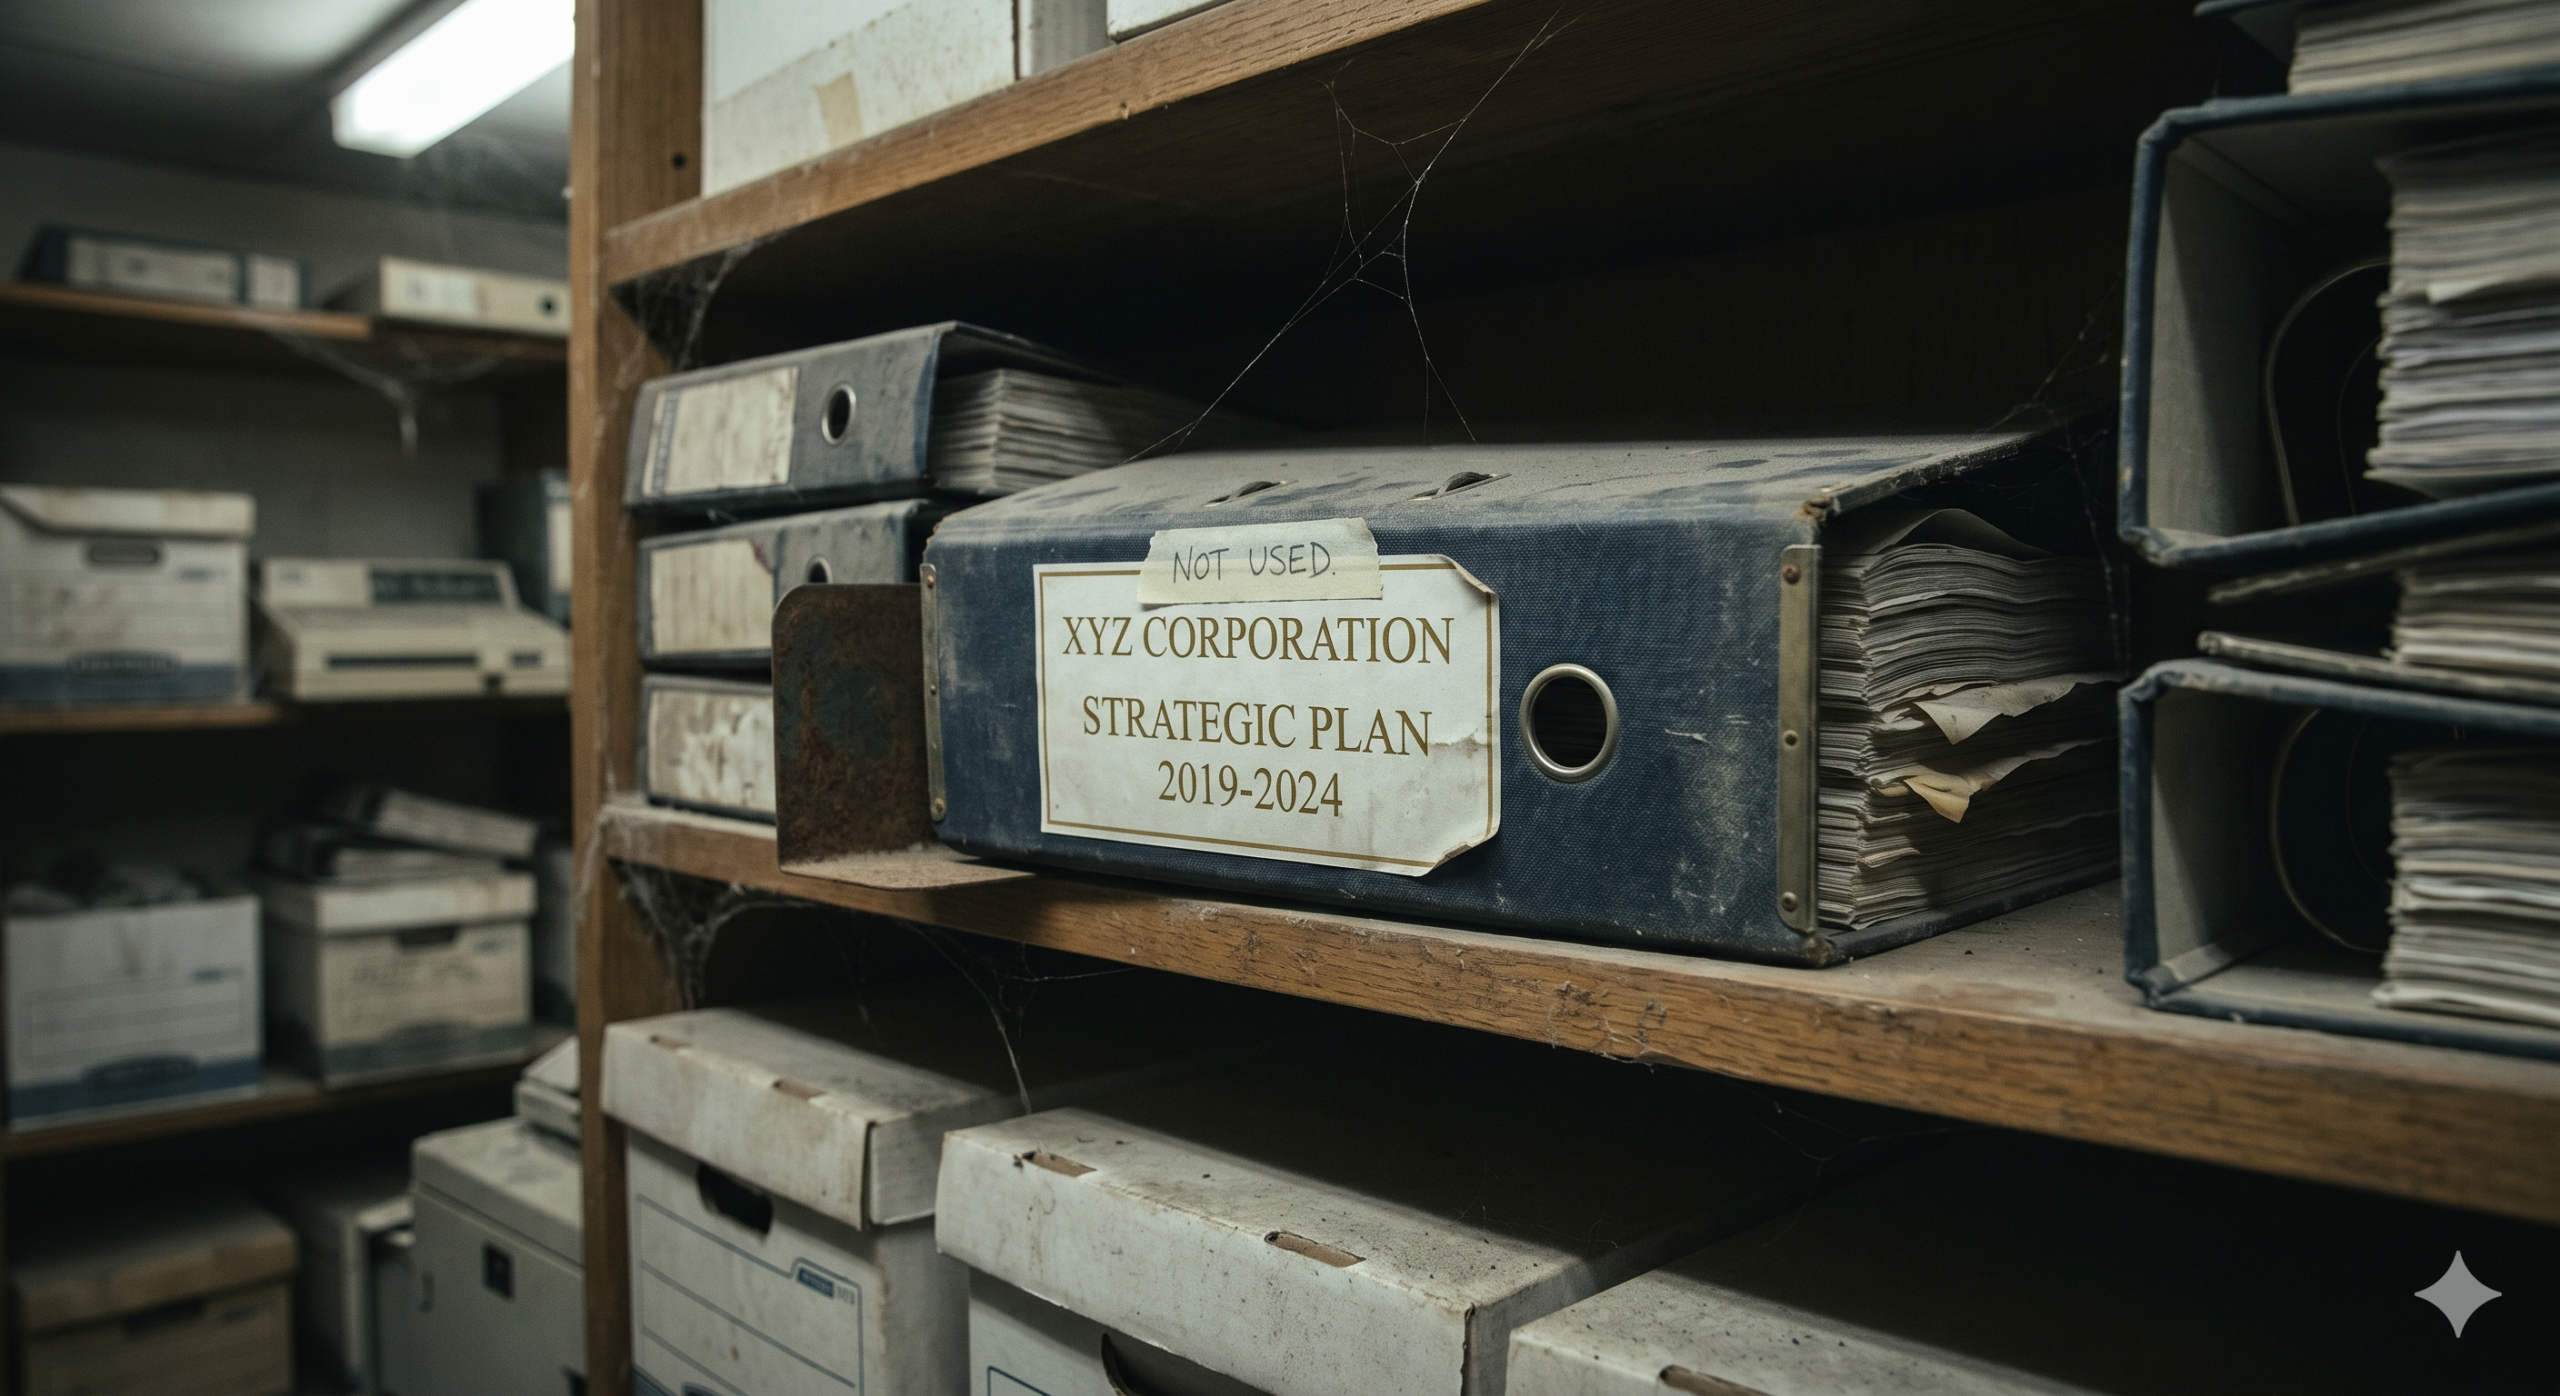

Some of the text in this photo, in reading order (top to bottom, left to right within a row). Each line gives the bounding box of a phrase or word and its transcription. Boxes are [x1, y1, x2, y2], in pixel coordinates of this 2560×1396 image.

[1173, 541, 1337, 583] NOT USED.
[1062, 616, 1455, 665] XYZ CORPORATION
[1082, 695, 1433, 757] STRATEGIC PLAN
[1157, 760, 1344, 818] 2019-2024
